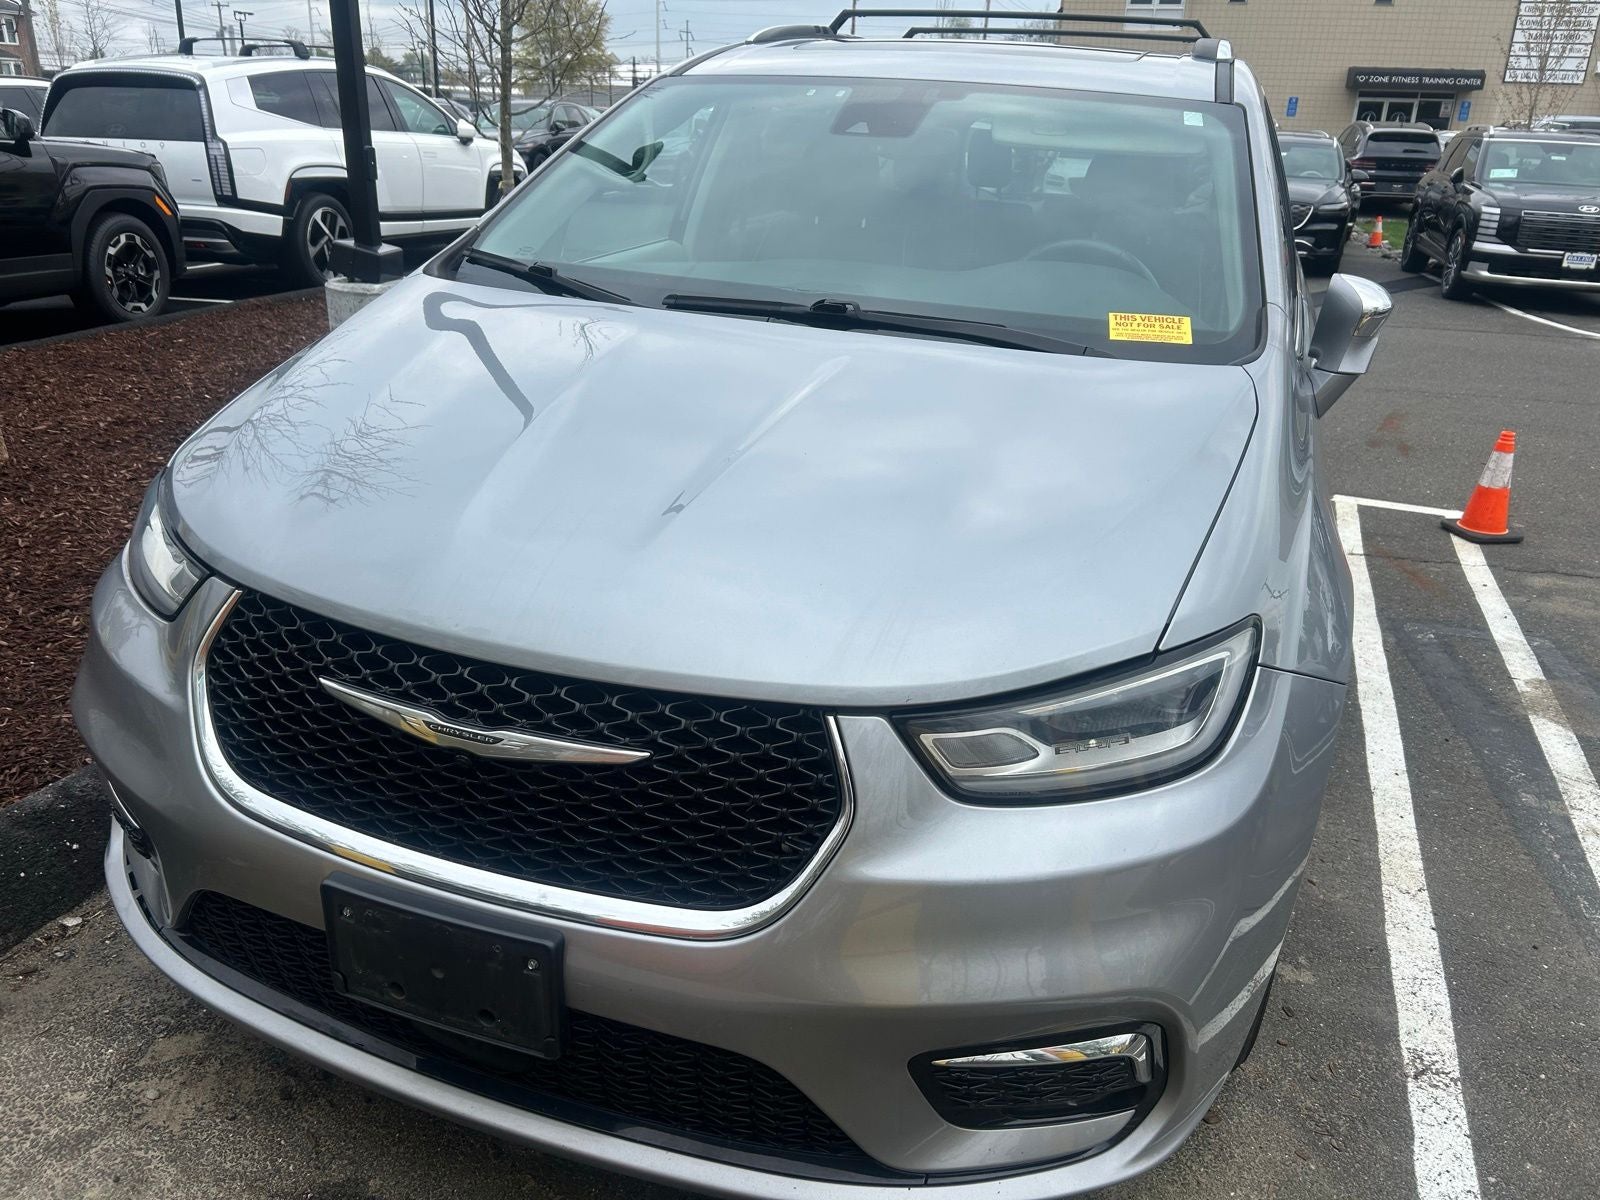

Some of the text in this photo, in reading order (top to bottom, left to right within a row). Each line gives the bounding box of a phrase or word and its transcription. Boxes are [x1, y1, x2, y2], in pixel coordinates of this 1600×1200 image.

[1369, 75, 1389, 83] ZONE
[1391, 76, 1419, 84] FITNESS
[1421, 77, 1454, 85] TRAINING
[1456, 77, 1482, 86] CENTER
[1140, 316, 1185, 325] VEHICLE
[429, 724, 495, 742] CHRYSLER
